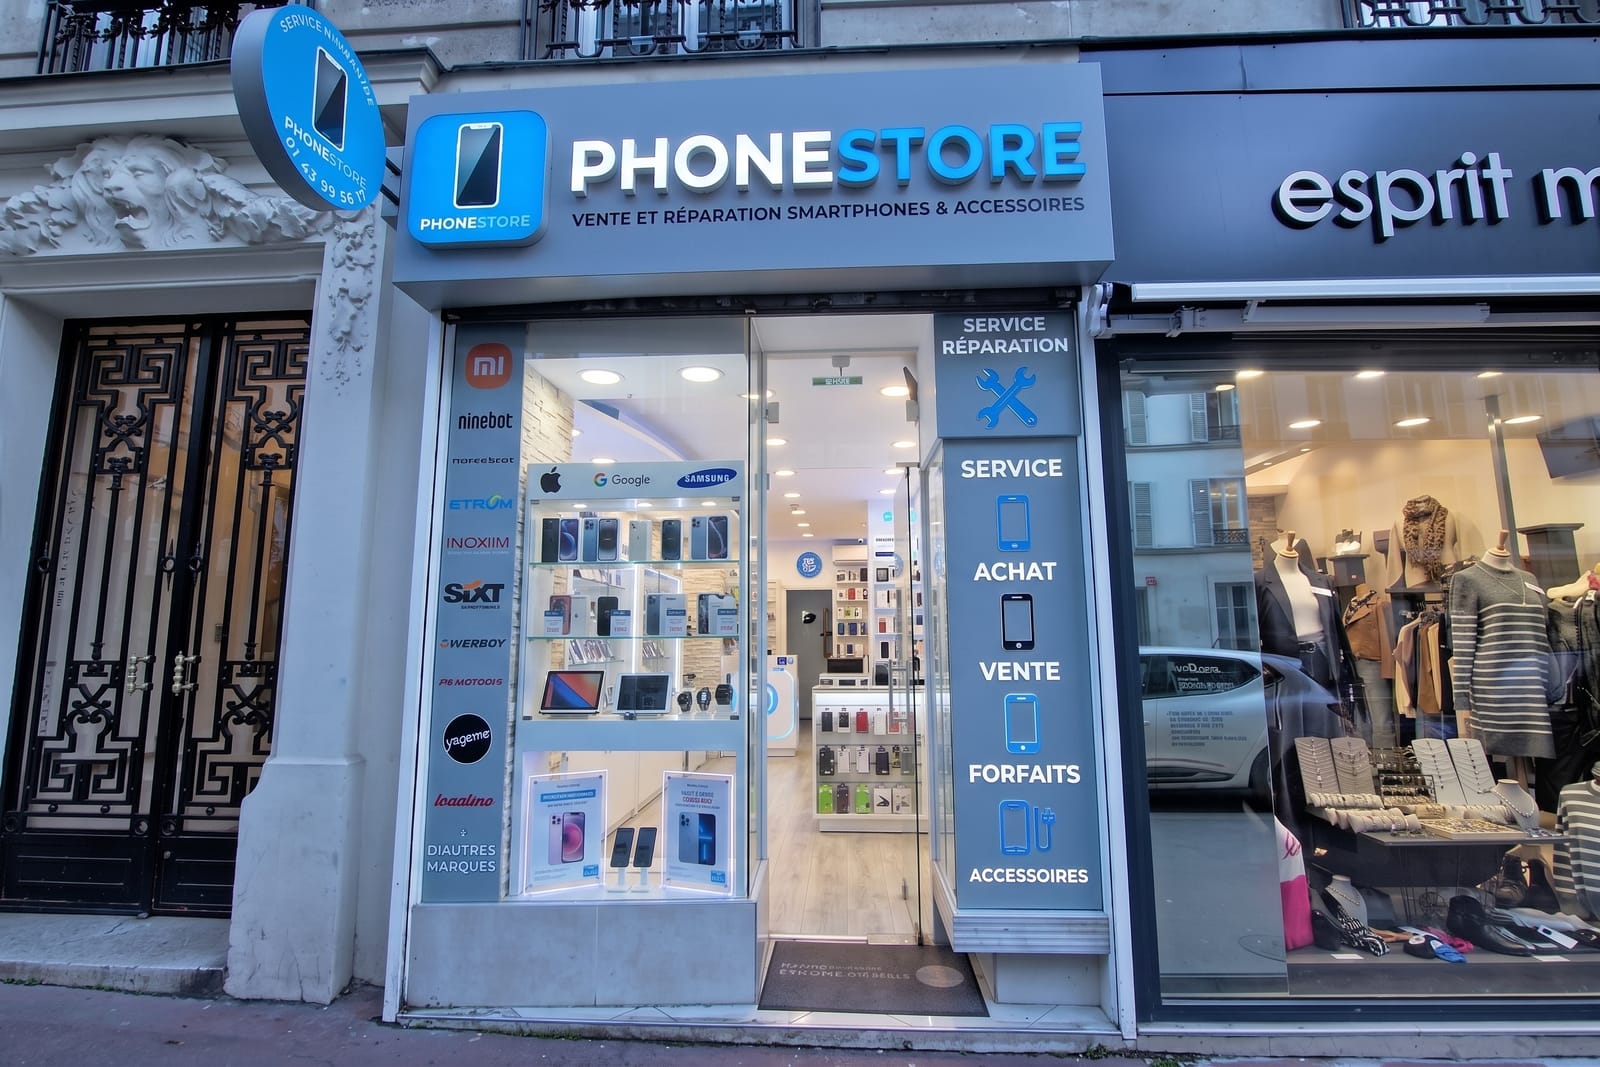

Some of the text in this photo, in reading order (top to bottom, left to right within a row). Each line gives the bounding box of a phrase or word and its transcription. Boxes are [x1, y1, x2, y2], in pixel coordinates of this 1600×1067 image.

[280, 14, 322, 33] SERVICE
[285, 116, 367, 191] PHONESTORE
[571, 121, 1087, 198] PHONESTORE
[286, 137, 300, 157] 01
[301, 163, 317, 181] 43
[321, 180, 335, 198] 99
[340, 190, 354, 204] 56
[1274, 151, 1513, 241] esprit
[572, 197, 1085, 227] VENTE ET RÉPARATION SMARTPHONES & ACCESSOIRES
[420, 214, 531, 231] PHONESTORE
[963, 316, 1046, 333] SERVICE
[942, 337, 1069, 355] RÉPARATION
[458, 411, 513, 430] ninebot
[961, 458, 1063, 478] SERVICE
[611, 474, 651, 487] Google
[684, 474, 730, 483] SAMSUNG
[973, 562, 1057, 581] ACHAT
[979, 661, 1061, 681] VENTE
[968, 764, 1081, 784] FORFAITS
[427, 861, 496, 874] MARQUES
[969, 868, 1089, 884] ACCESSOIRES
